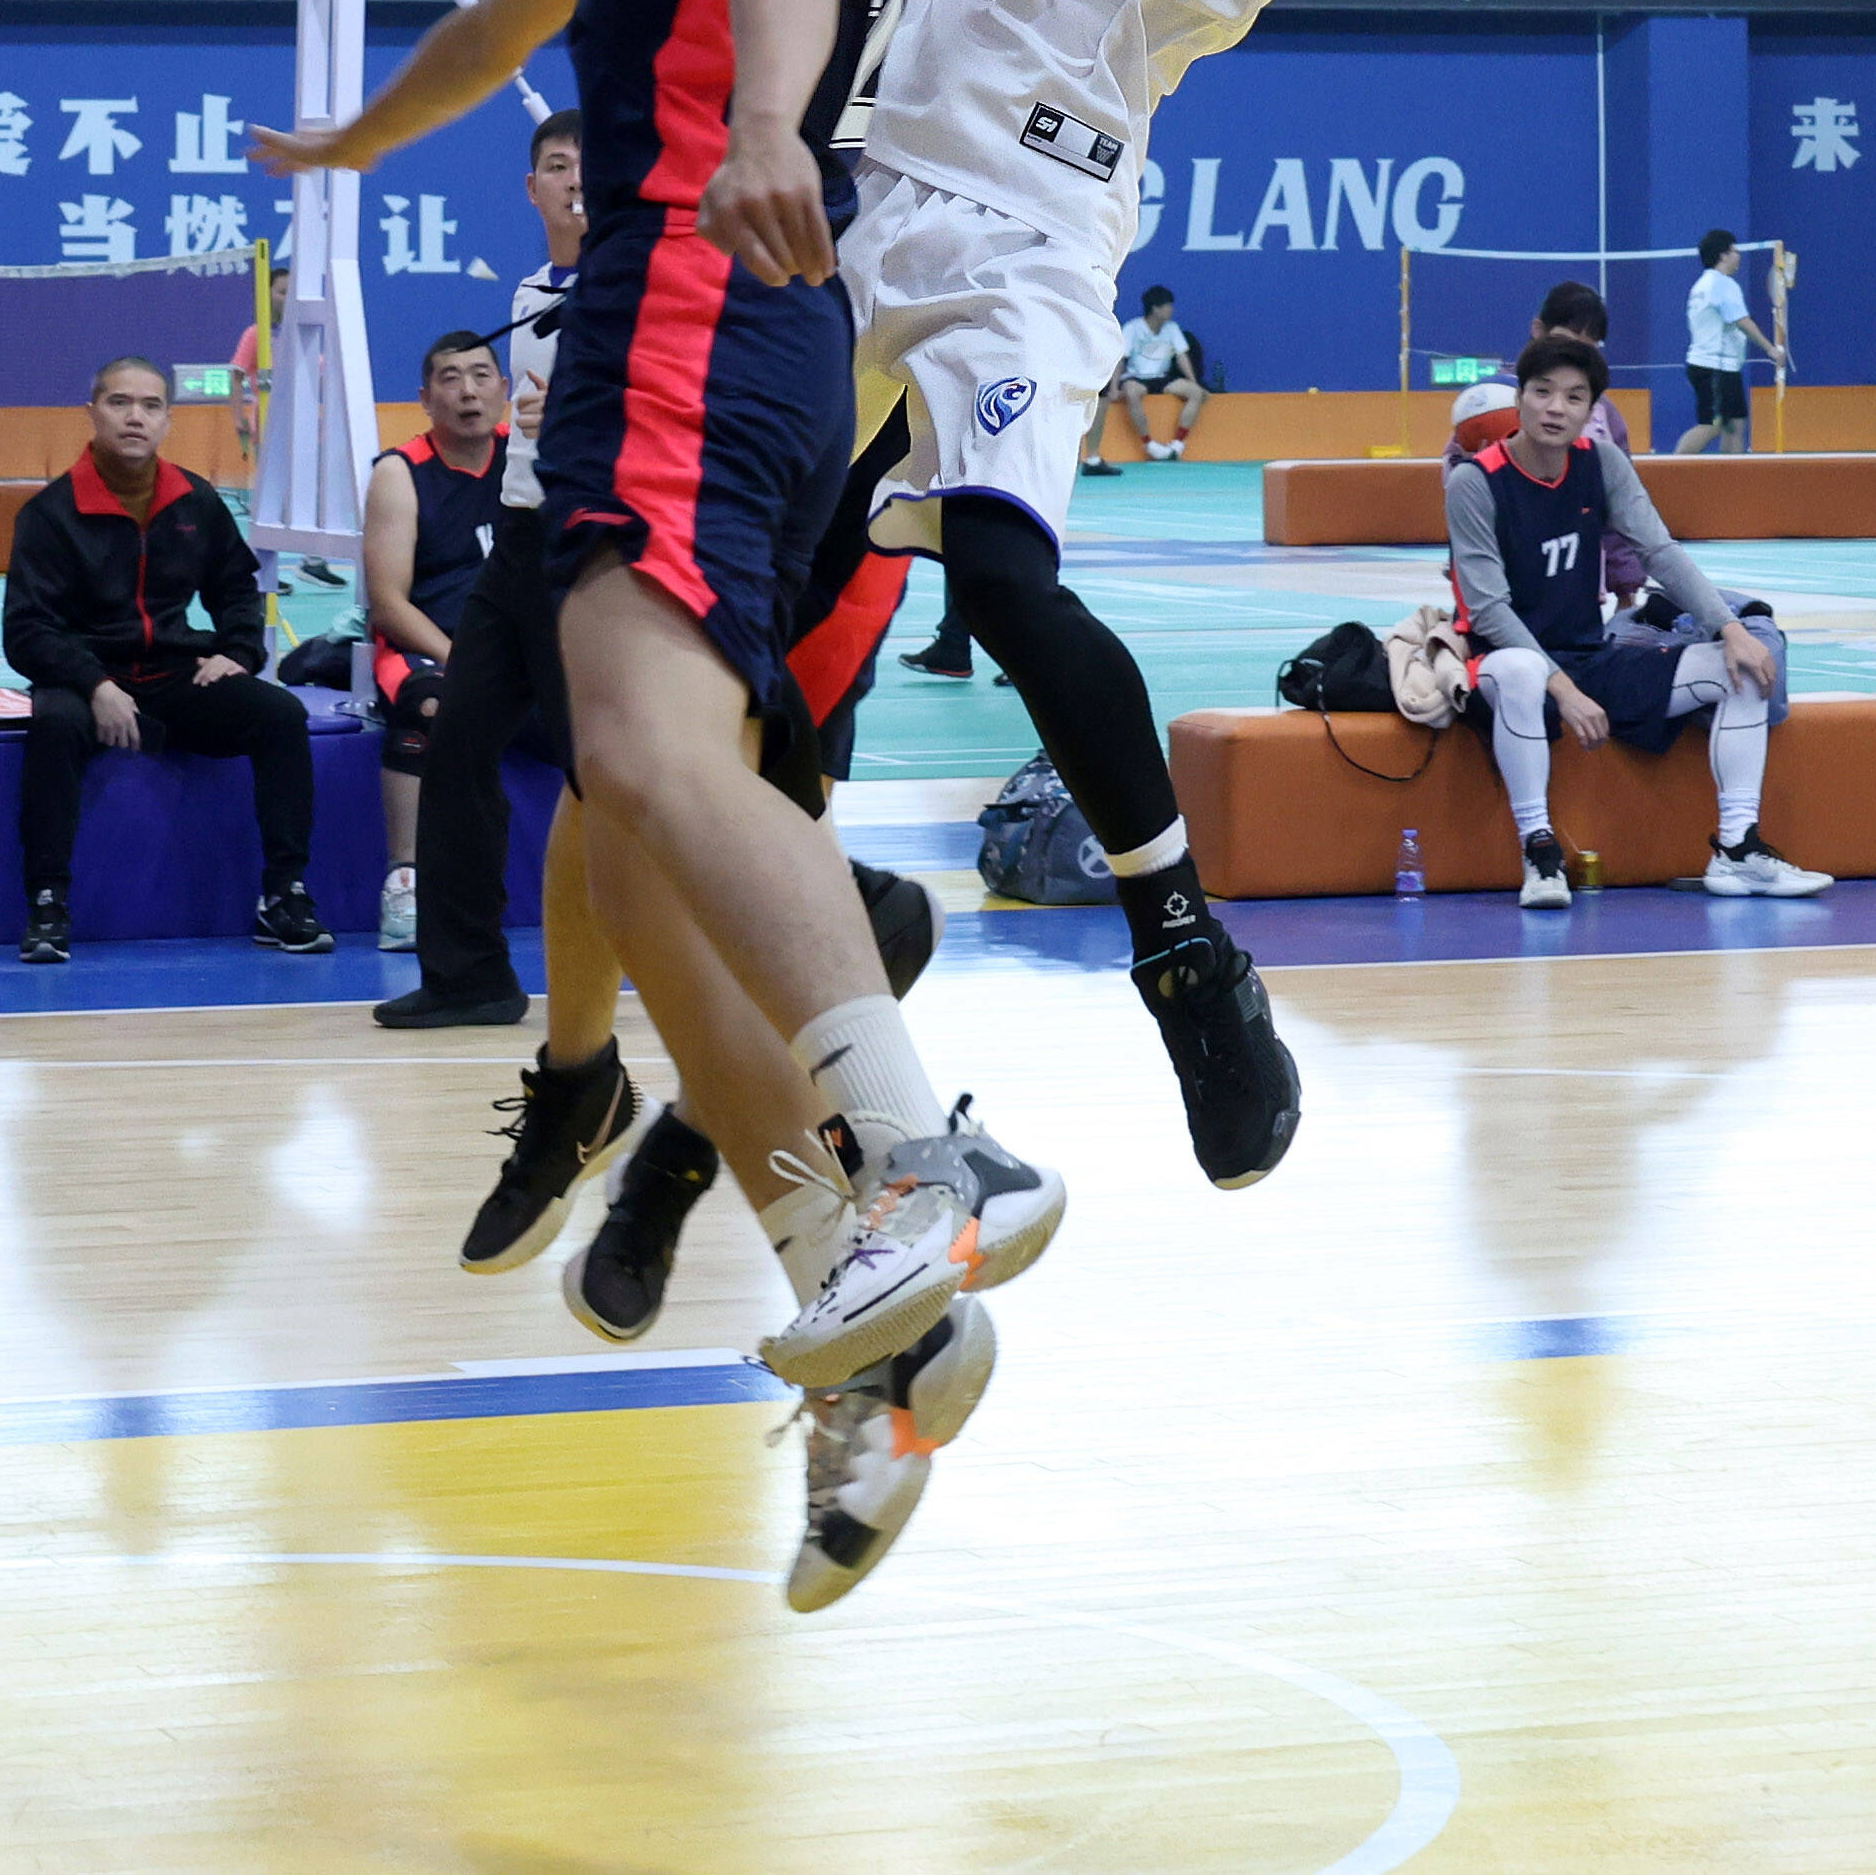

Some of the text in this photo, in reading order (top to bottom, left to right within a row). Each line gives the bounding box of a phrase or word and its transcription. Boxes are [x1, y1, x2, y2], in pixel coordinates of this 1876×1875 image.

[58, 193, 459, 276] 当燃让
[1541, 532, 1580, 578] 77
